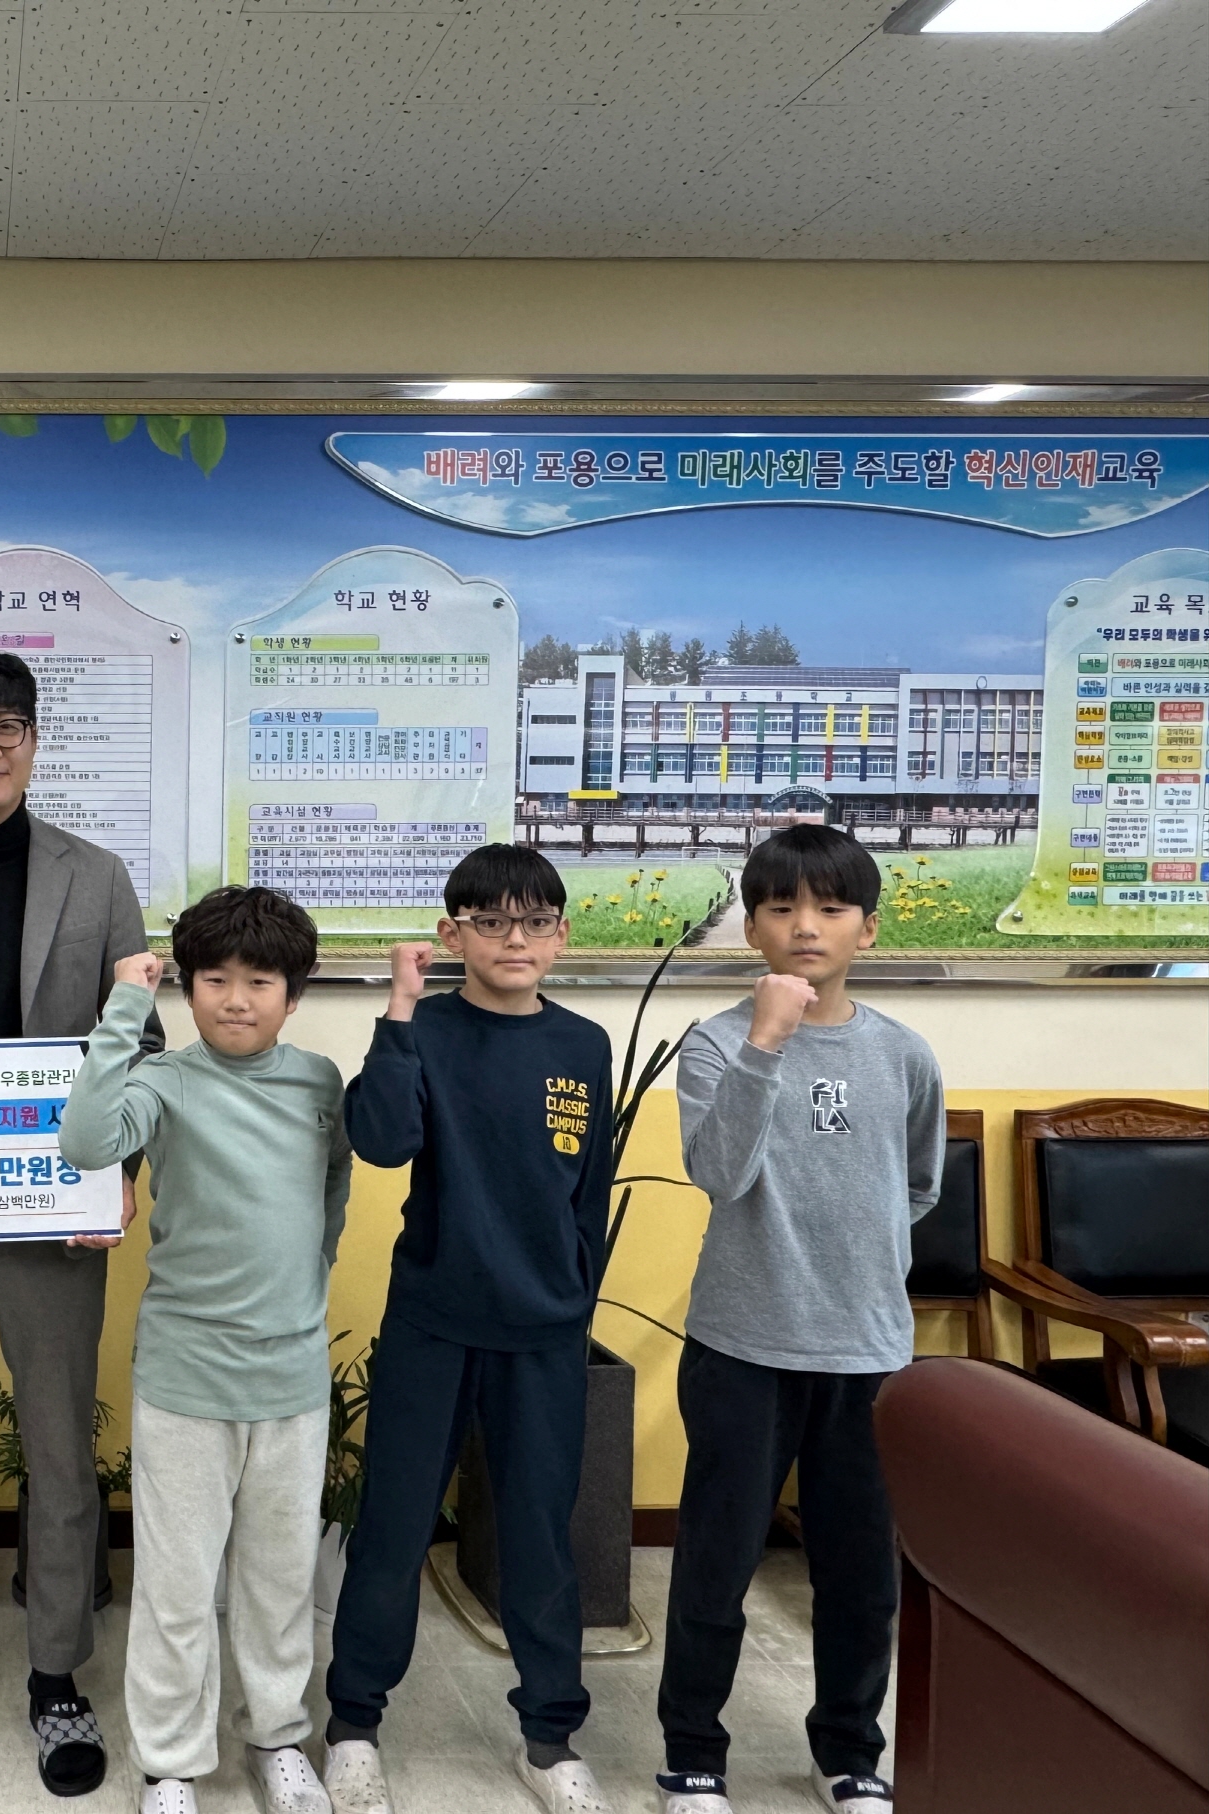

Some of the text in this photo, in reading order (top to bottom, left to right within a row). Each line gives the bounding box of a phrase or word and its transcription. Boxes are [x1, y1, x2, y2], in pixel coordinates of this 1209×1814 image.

[423, 448, 1164, 490] 배려와 포용으로 미래사회를 주도할 혁신인재교육
[39, 590, 81, 611] 연혁
[334, 590, 431, 611] 학교 현황
[1130, 594, 1209, 615] 교육 목
[15, 634, 25, 646] 길
[264, 638, 312, 649] 학생 현황
[1129, 628, 1162, 641] 모두의
[1166, 628, 1200, 641] 학생을
[1123, 682, 1200, 693] 바른 인성과 실력을
[262, 711, 323, 722] 교직원 현황
[312, 806, 333, 817] 현황
[546, 1077, 588, 1098] C.M.P.S.
[546, 1096, 589, 1116] CLASSIC
[0, 1106, 40, 1128] 지원
[546, 1114, 587, 1134] CAMPUS
